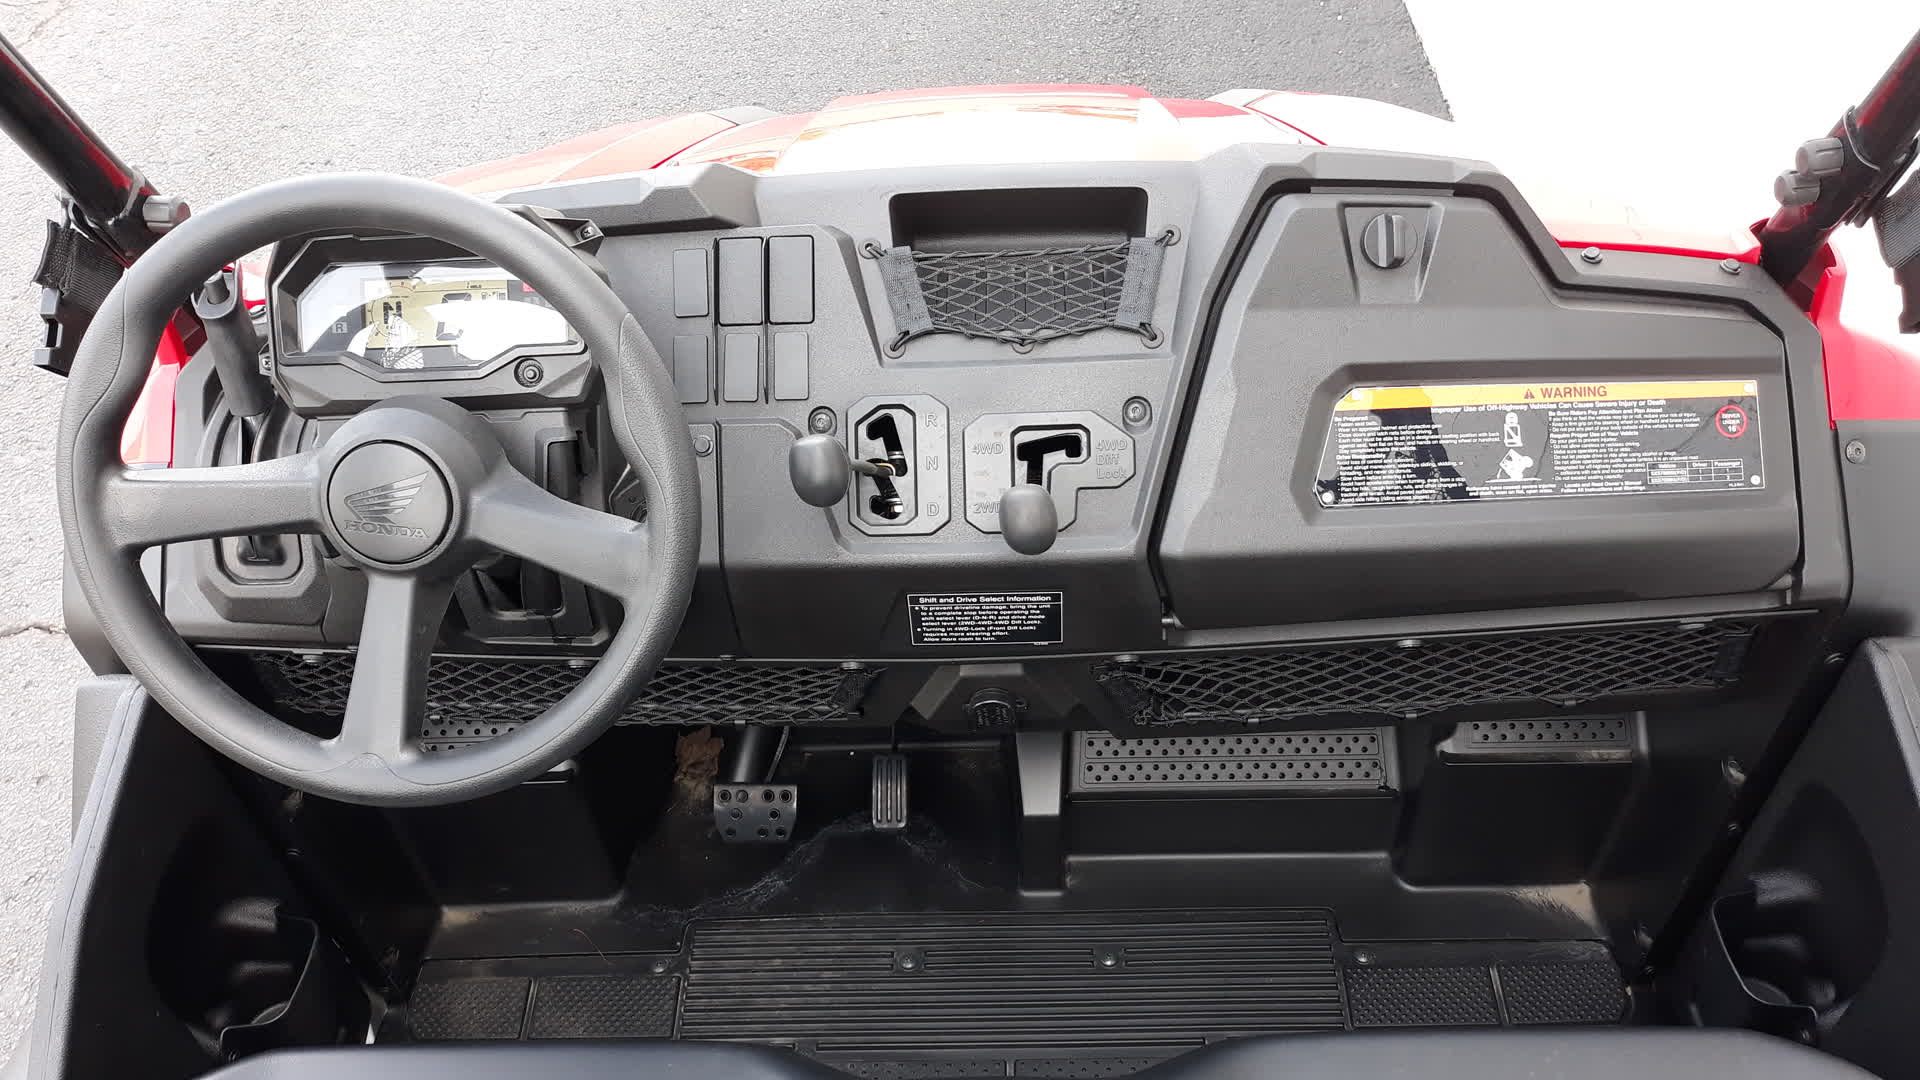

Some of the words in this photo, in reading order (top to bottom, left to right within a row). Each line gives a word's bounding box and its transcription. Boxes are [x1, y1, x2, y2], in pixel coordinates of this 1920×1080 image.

[336, 323, 344, 332] R
[1540, 386, 1608, 398] WARNING
[1431, 406, 1463, 414] Improper
[1487, 404, 1529, 412] Off-Highway
[925, 412, 937, 427] R
[972, 442, 1004, 455] 4WD
[926, 456, 938, 470] N
[1096, 467, 1127, 479] Lock
[926, 503, 939, 518] D
[344, 520, 430, 538] HONDA
